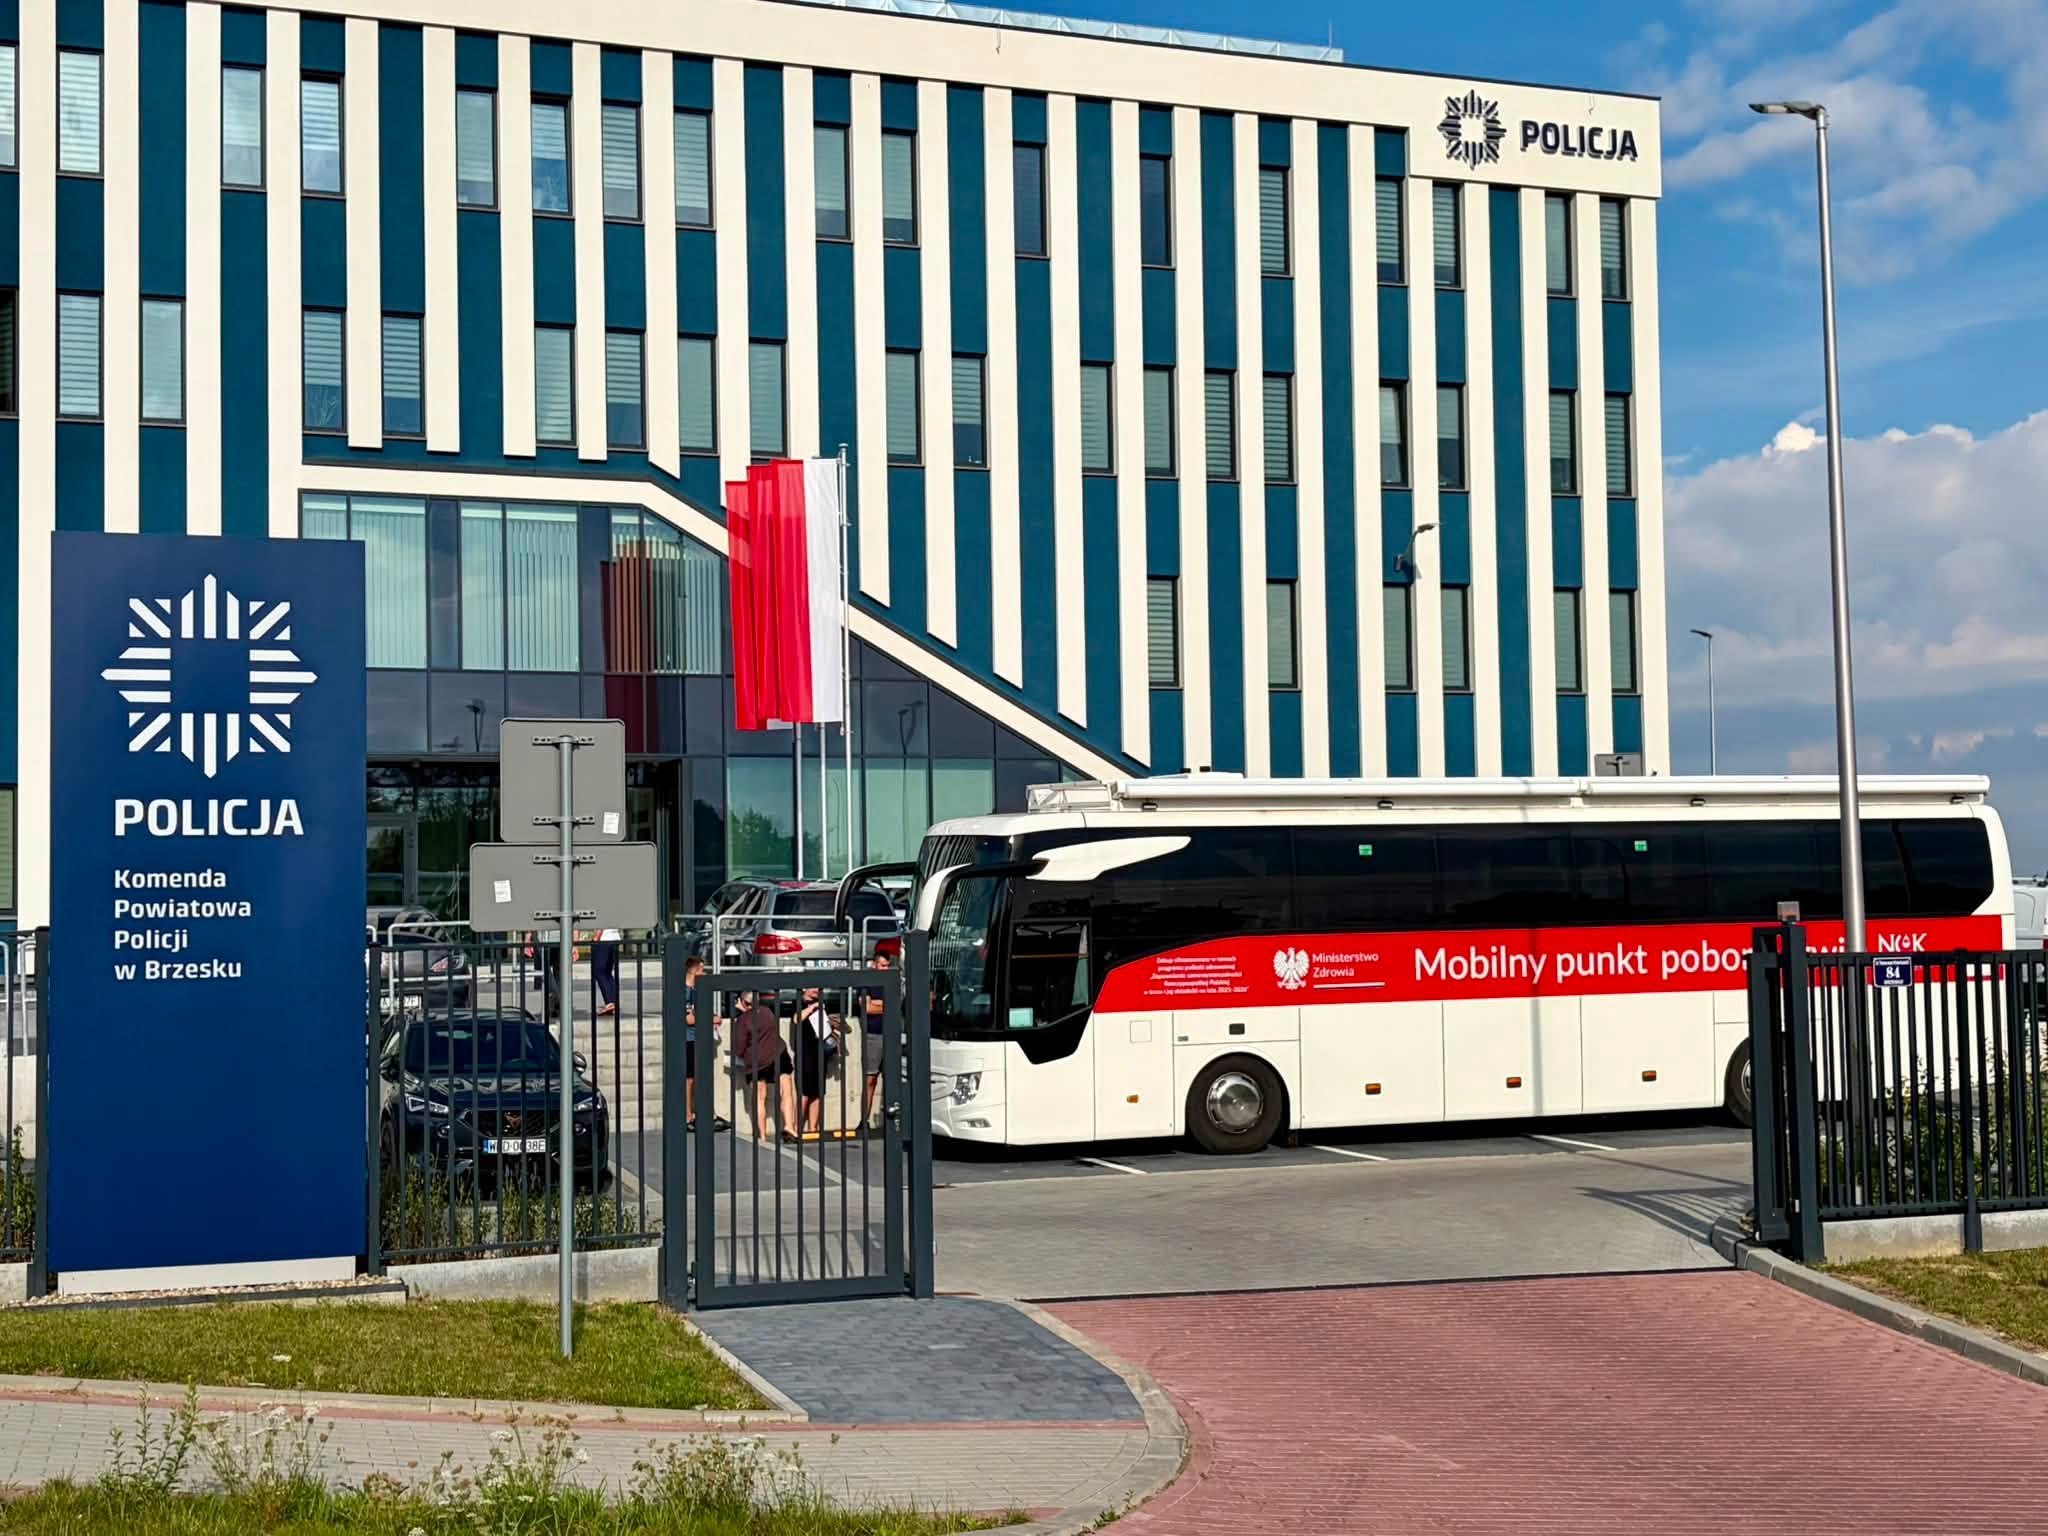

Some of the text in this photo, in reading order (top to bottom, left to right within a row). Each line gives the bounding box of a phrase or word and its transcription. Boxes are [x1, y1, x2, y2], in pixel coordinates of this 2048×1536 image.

[1521, 119, 1638, 161] POLICJA
[114, 798, 304, 837] POLICJA
[114, 868, 227, 889] Komenda
[114, 899, 252, 919] Powiatowa
[114, 929, 188, 953] Policji
[1312, 951, 1379, 964] Ministerstwo
[1415, 940, 1753, 985] Mobilny punkt pobor
[114, 959, 242, 981] w Brzesku
[1312, 966, 1355, 979] Zdrowia
[1886, 966, 1900, 979] 84
